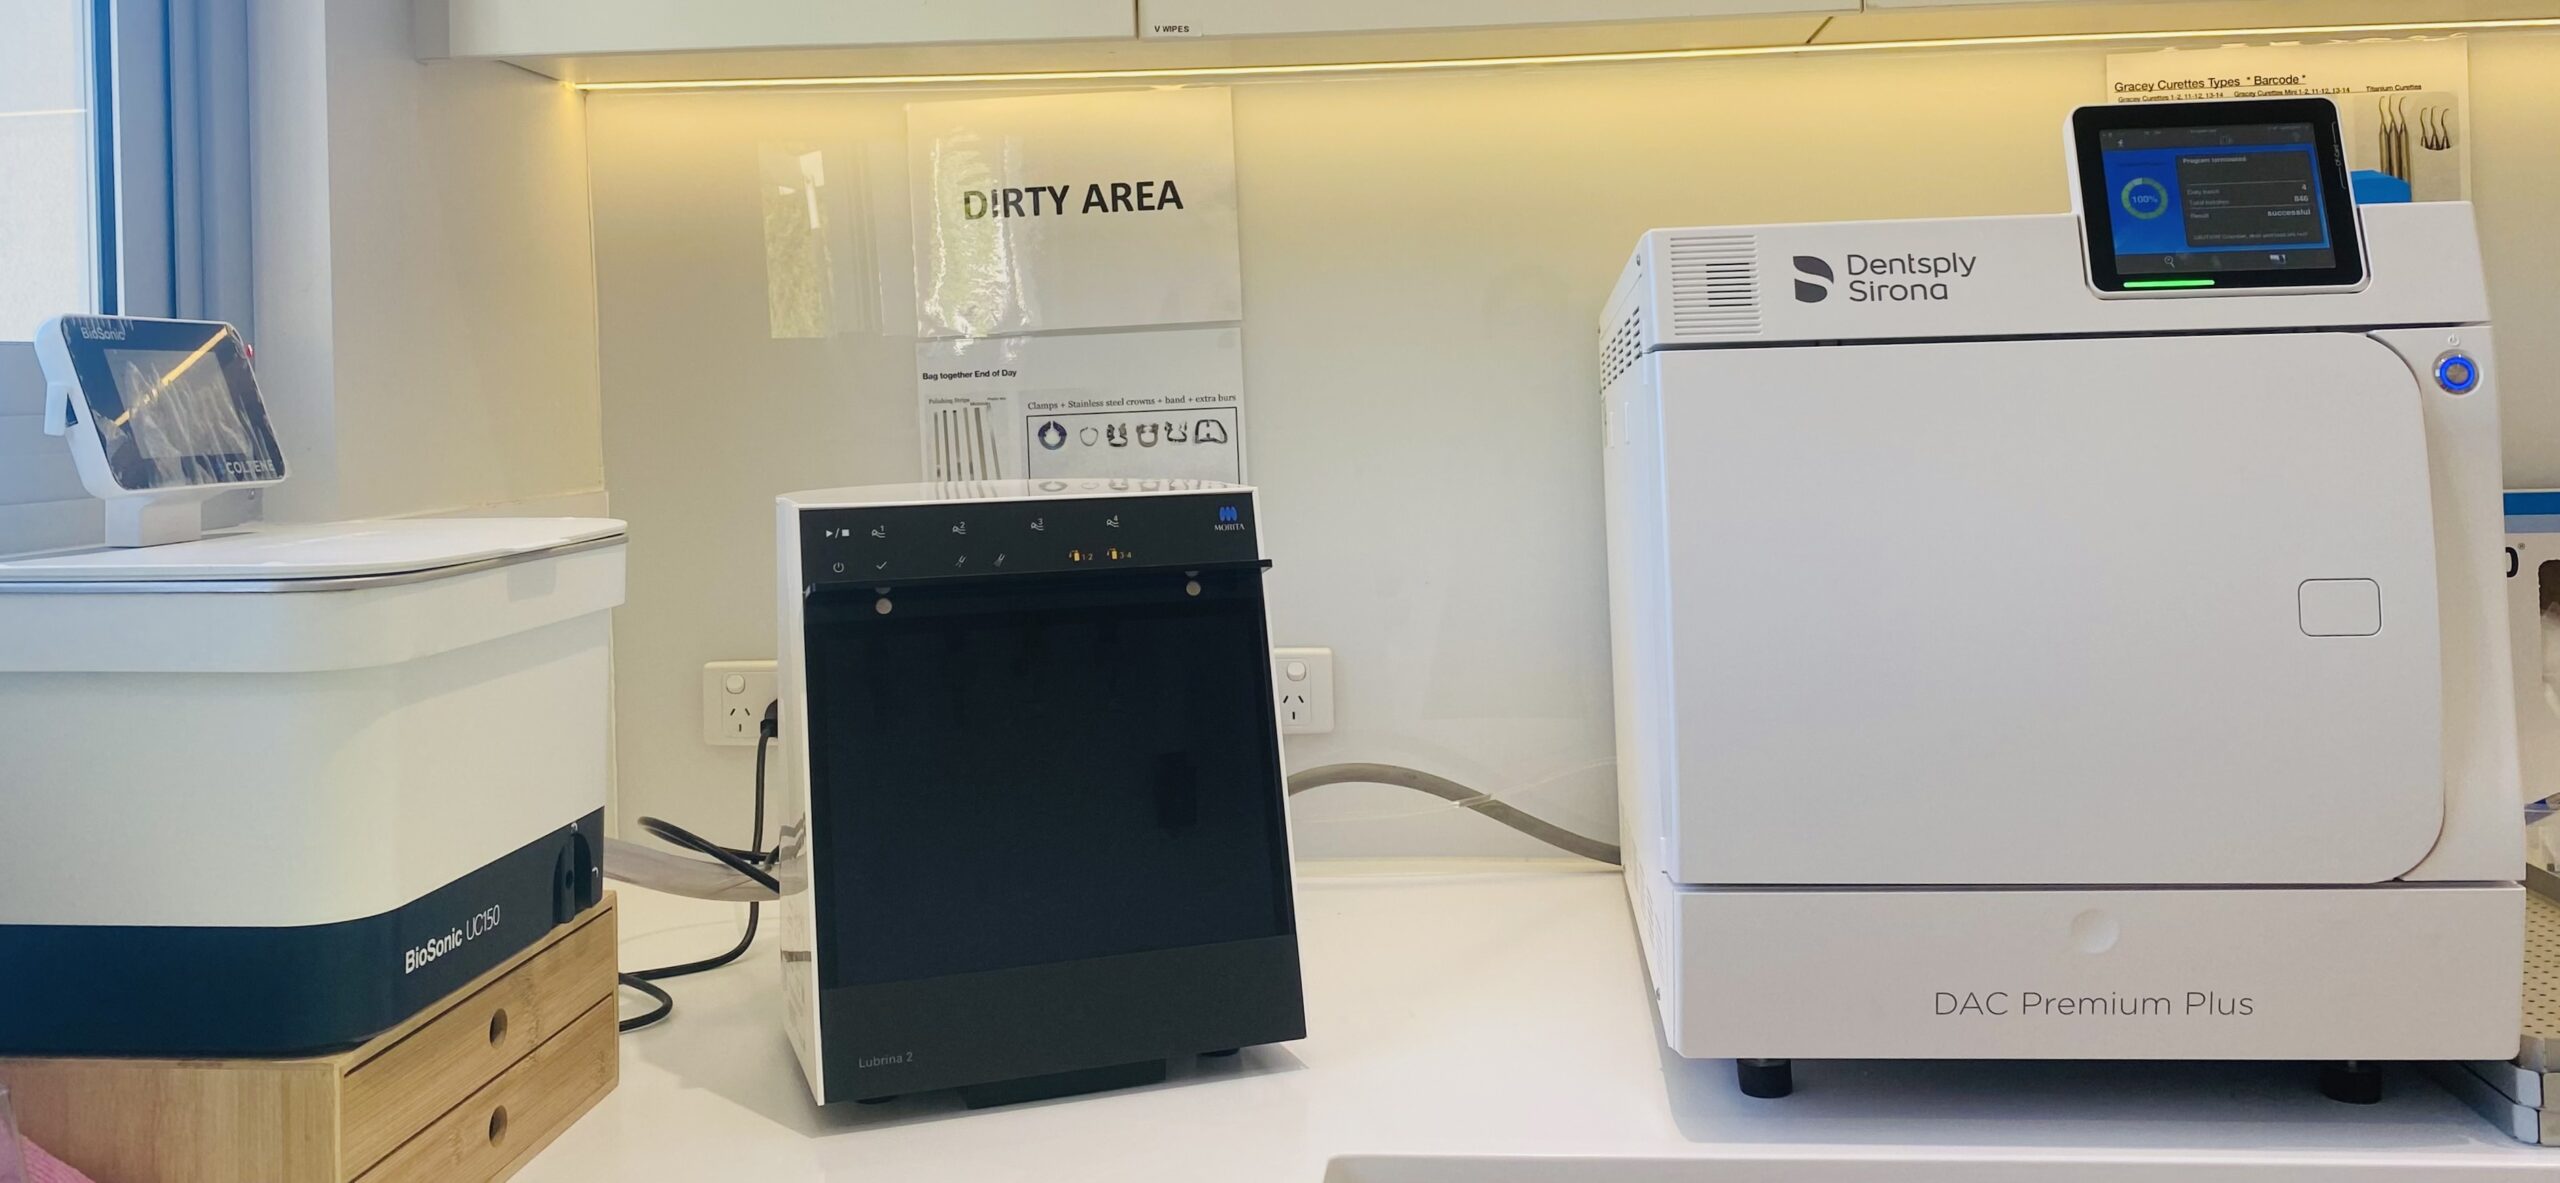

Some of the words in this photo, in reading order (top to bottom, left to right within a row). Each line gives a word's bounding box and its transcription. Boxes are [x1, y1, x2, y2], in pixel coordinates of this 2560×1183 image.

[1154, 25, 1160, 33] V
[1162, 25, 1190, 33] WIPES
[2114, 81, 2155, 92] Gracey
[2157, 79, 2205, 90] Curettes
[2207, 77, 2241, 89] Types
[2253, 74, 2300, 85] Barcode
[963, 184, 1070, 220] DIRTY
[1081, 179, 1184, 214] AREA
[2132, 194, 2158, 204] 100%
[2267, 208, 2311, 217] successful
[1846, 252, 1977, 278] Dentsply
[1849, 279, 1949, 302] Sirona
[80, 326, 126, 341] BioSonic
[922, 372, 939, 380] Bag
[940, 371, 973, 380] together
[974, 370, 990, 378] End
[992, 369, 1000, 377] of
[1001, 369, 1017, 378] Day
[1027, 401, 1058, 411] Clamps
[1068, 399, 1104, 408] Stainless
[1105, 397, 1124, 407] steel
[1126, 398, 1155, 406] crowns
[1165, 394, 1185, 404] band
[1195, 395, 1216, 403] extra
[1217, 393, 1236, 402] burs
[1214, 522, 1245, 531] MORITA
[405, 927, 463, 975] BioSonic
[465, 904, 500, 941] UC150
[1935, 991, 2009, 1016] DAC
[2022, 991, 2172, 1016] Premium
[2186, 990, 2254, 1016] Plus
[858, 1055, 903, 1069] Lubrina
[905, 1051, 913, 1063] 2
